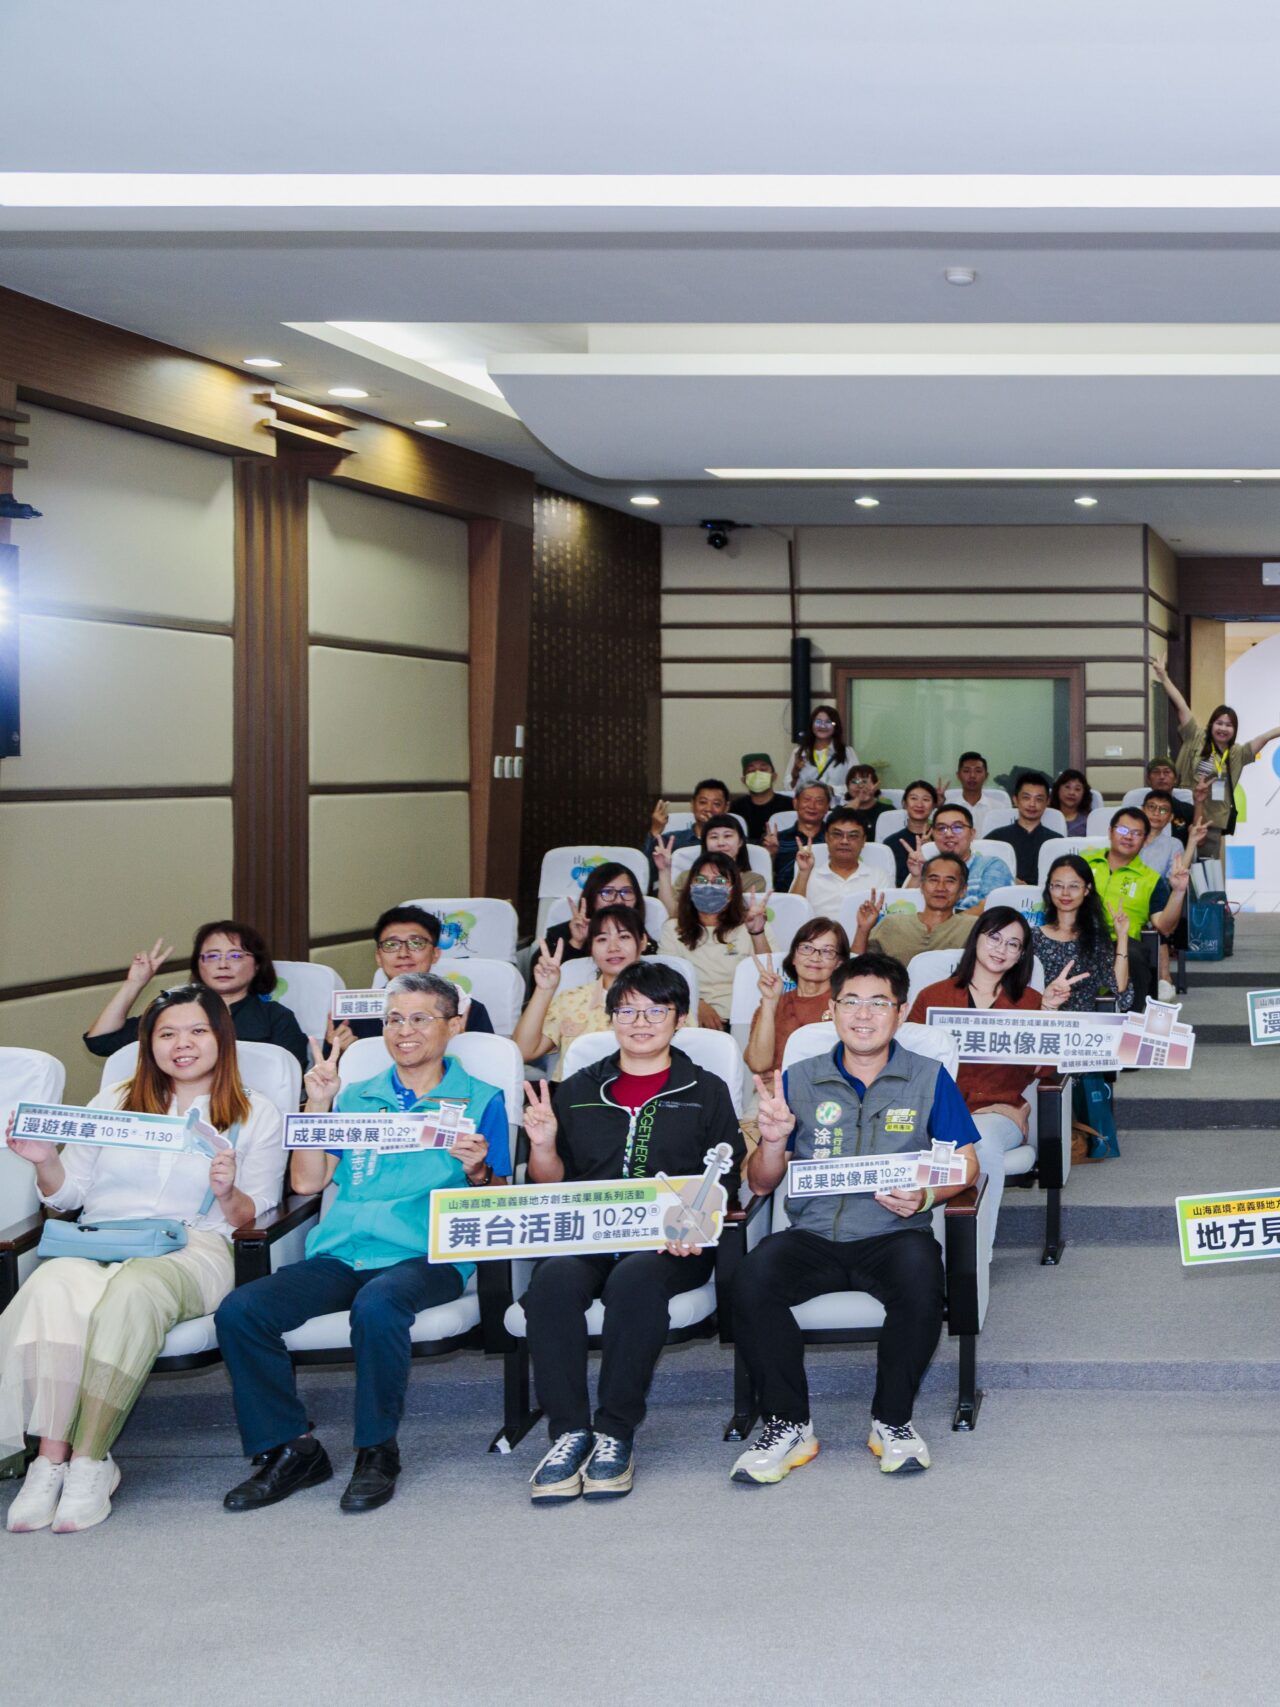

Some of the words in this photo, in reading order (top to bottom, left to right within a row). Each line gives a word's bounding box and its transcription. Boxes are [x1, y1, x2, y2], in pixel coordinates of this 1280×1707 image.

[951, 1029, 1061, 1056] 果映像展
[1063, 1033, 1104, 1048] 10/29
[21, 1116, 98, 1139] 漫遊集章
[292, 1127, 380, 1143] 成果映像展
[633, 1100, 659, 1163] TOGETHER
[798, 1169, 879, 1191] 成果映像展
[448, 1190, 645, 1211] 山海嘉境-嘉義縣地方創生成果展系列活動
[449, 1210, 585, 1248] 舞台活動
[592, 1206, 647, 1228] 10/29
